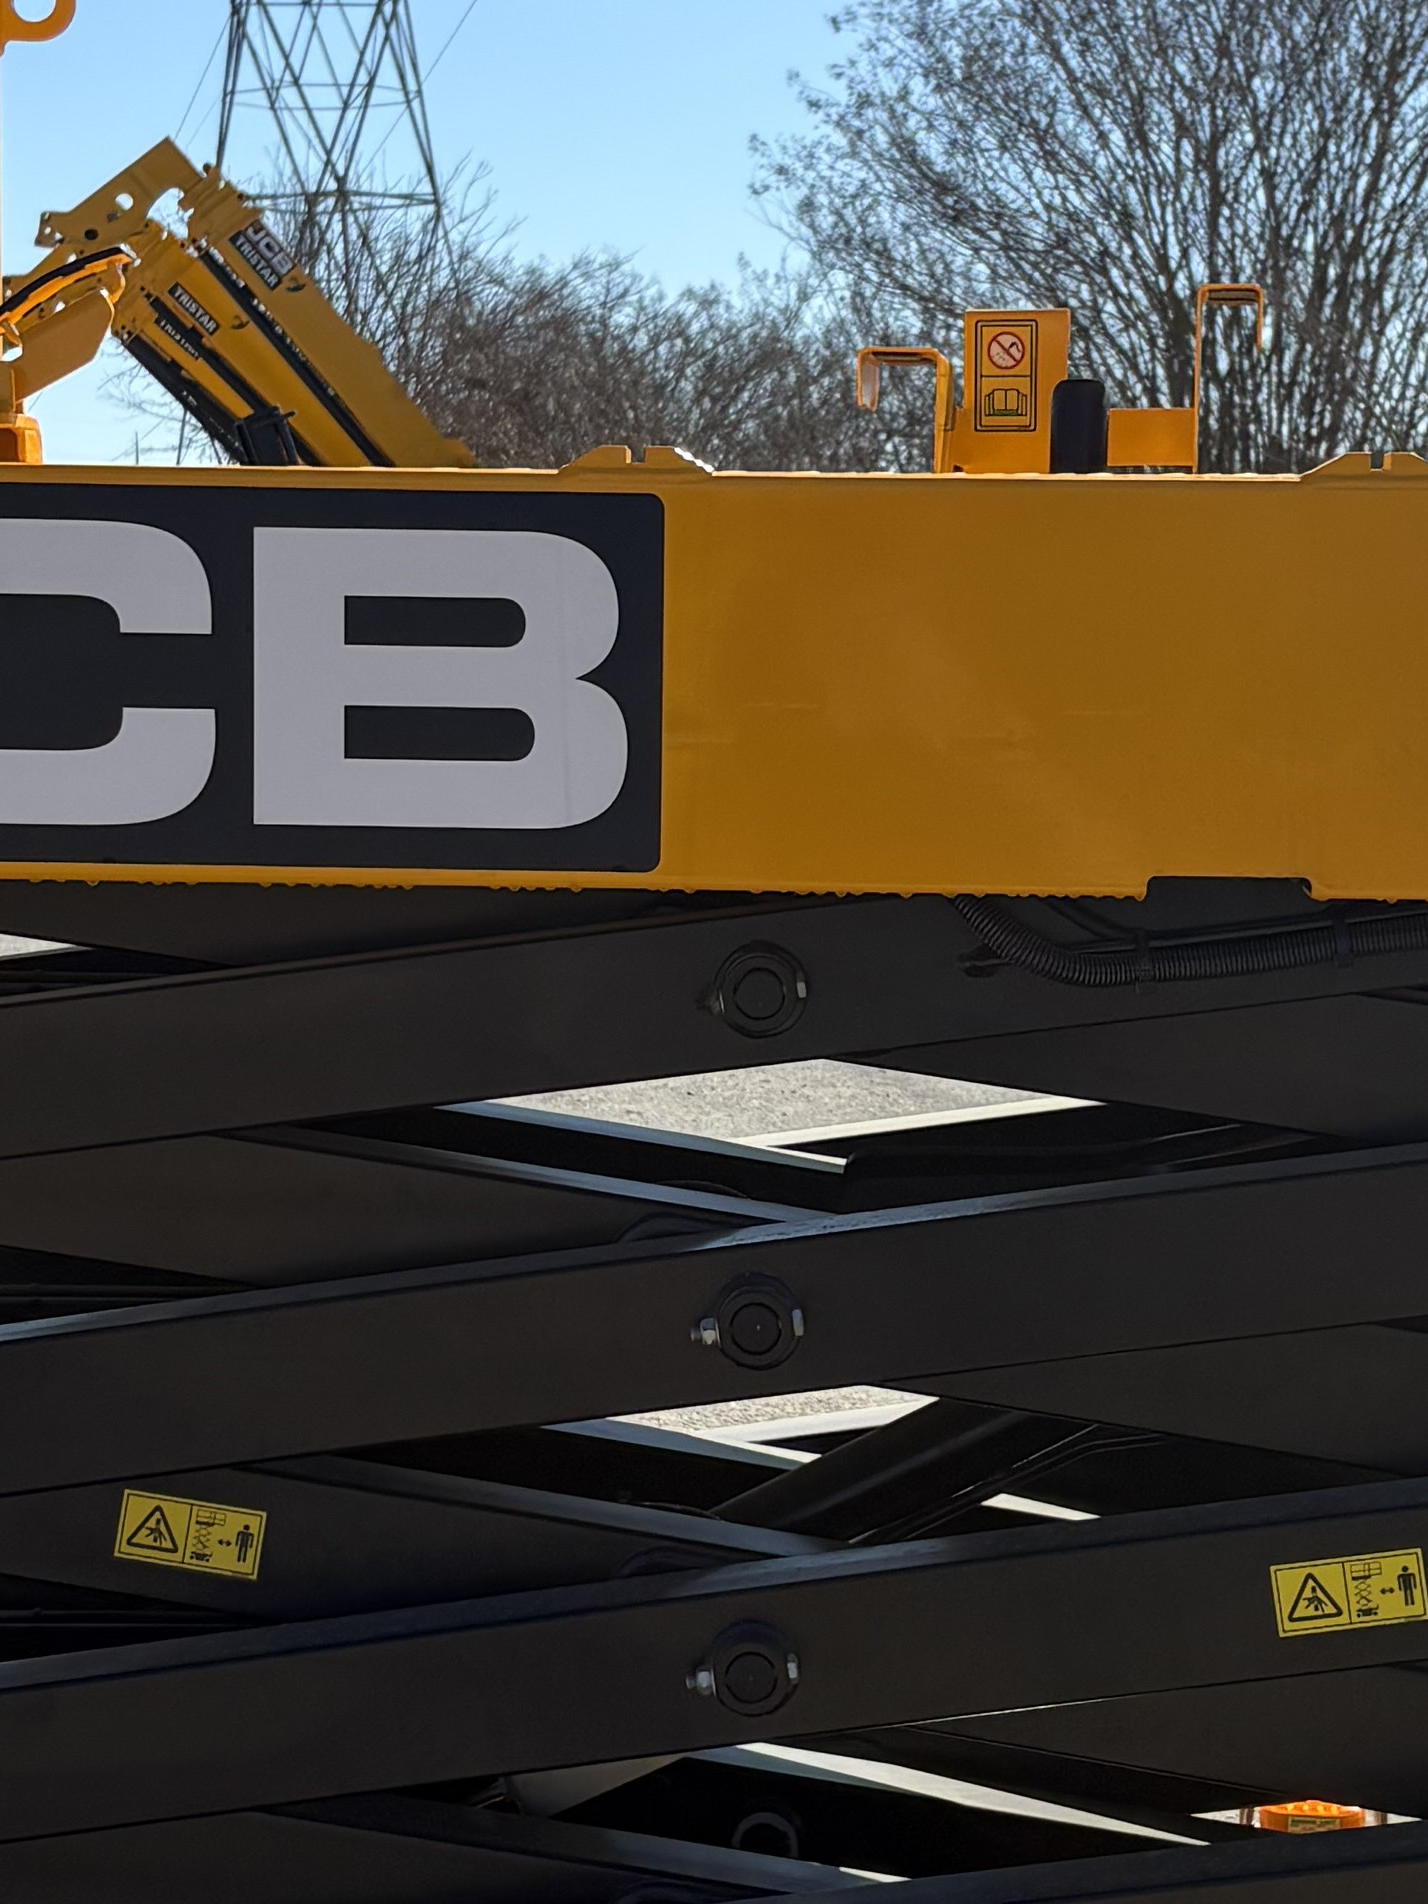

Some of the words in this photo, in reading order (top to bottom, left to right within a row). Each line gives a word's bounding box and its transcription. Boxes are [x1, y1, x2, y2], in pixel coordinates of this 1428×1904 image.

[235, 235, 279, 288] TRISTAR
[246, 226, 293, 275] JCB
[174, 287, 218, 334] TRISTAR
